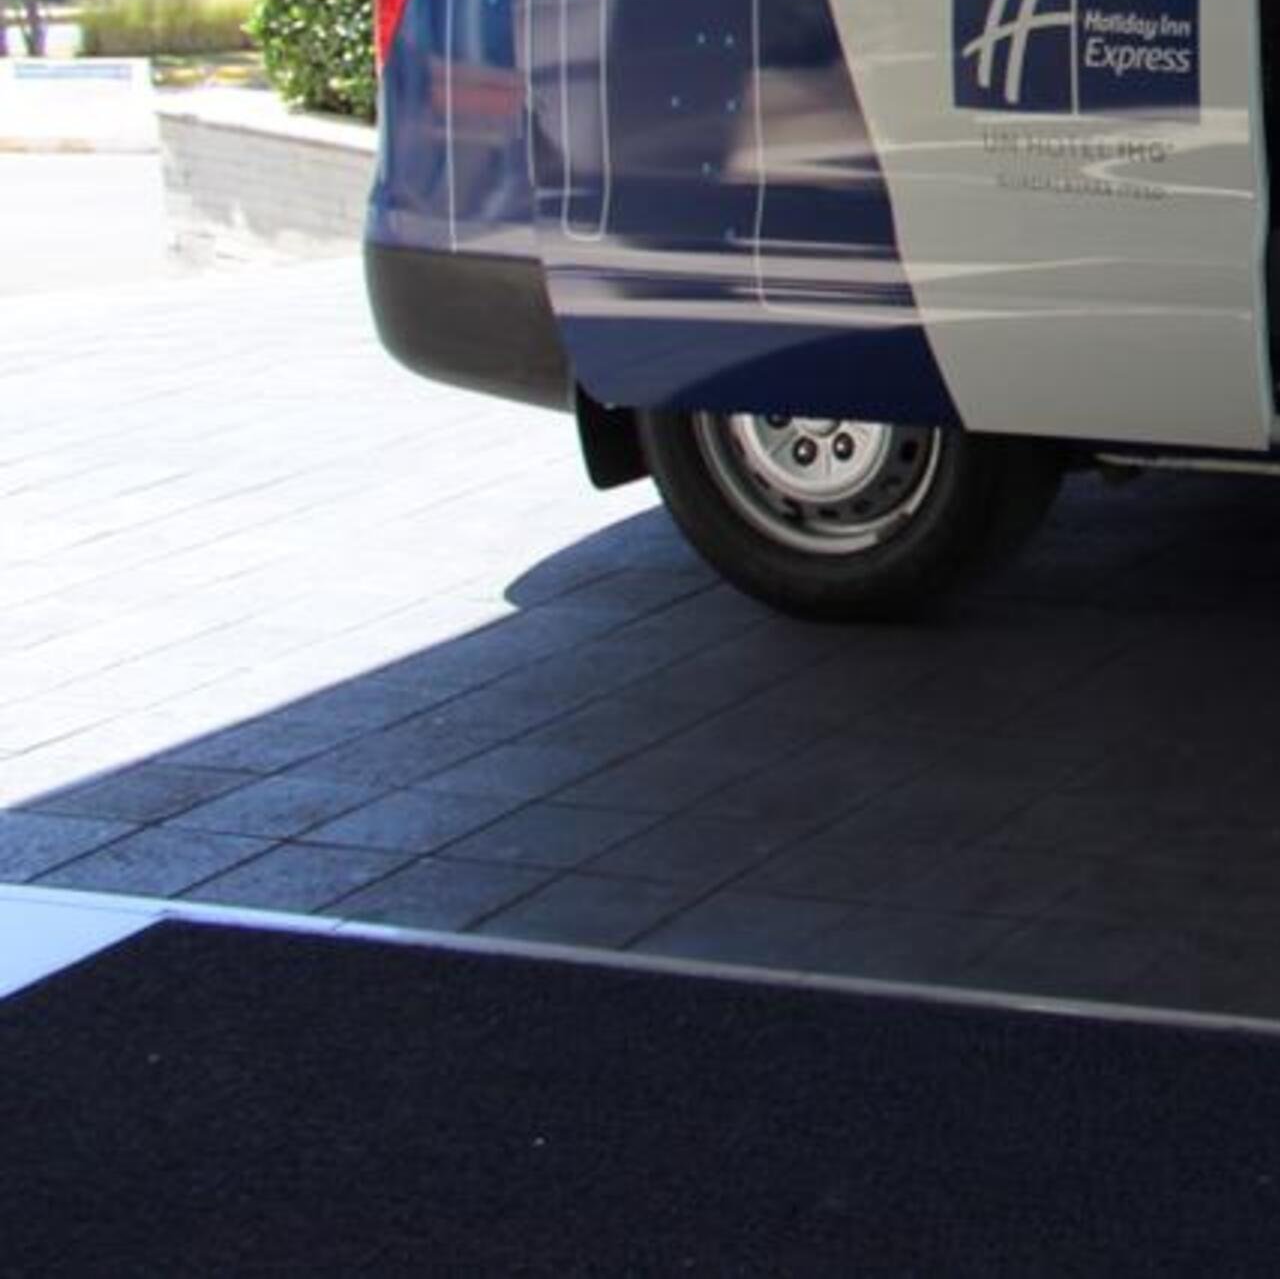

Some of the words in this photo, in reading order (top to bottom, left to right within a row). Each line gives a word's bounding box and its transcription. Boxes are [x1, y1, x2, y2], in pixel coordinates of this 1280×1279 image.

[1085, 9, 1156, 40] Holiday
[1160, 13, 1191, 37] Inn
[1085, 36, 1191, 77] Express
